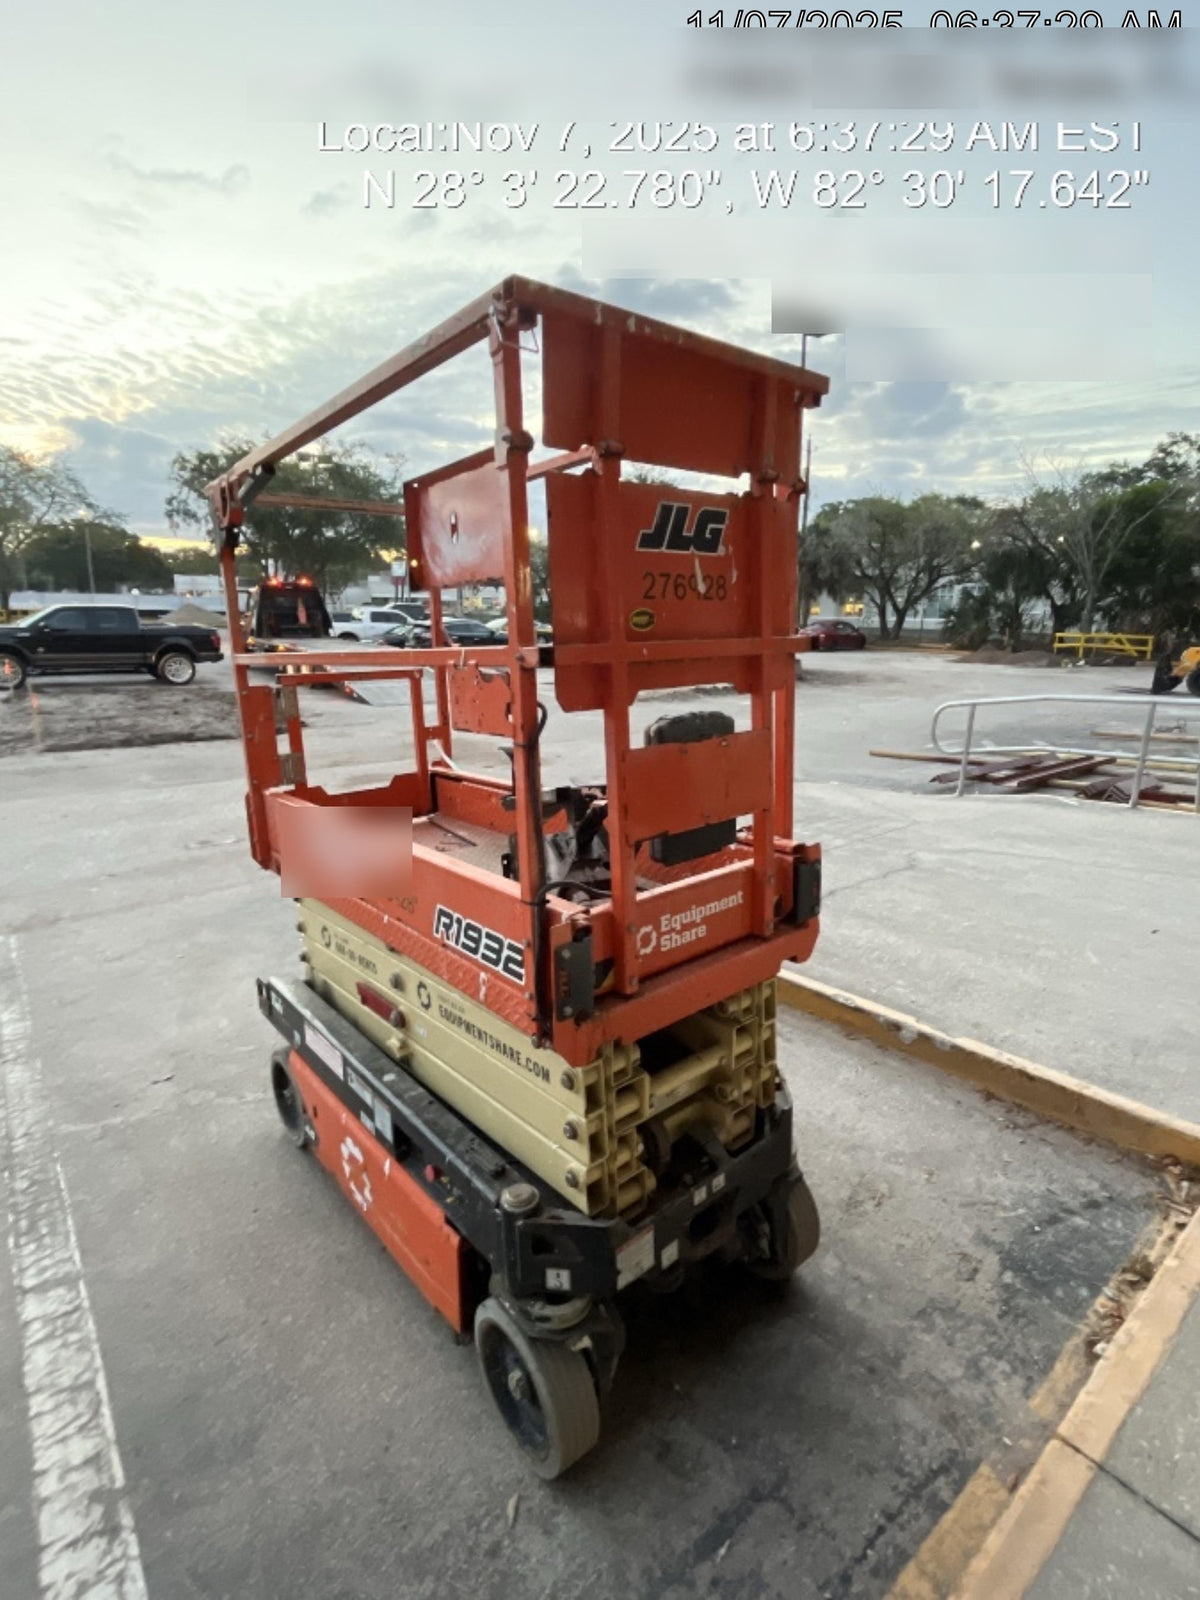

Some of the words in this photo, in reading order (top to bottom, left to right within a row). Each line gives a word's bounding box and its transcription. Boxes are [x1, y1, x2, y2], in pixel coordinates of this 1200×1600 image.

[636, 501, 729, 556] JLG
[660, 890, 744, 932] Equipment
[660, 924, 707, 952] Share
[433, 904, 526, 986] R1932
[438, 1005, 552, 1085] EQUIPMENTSHARE.COM
